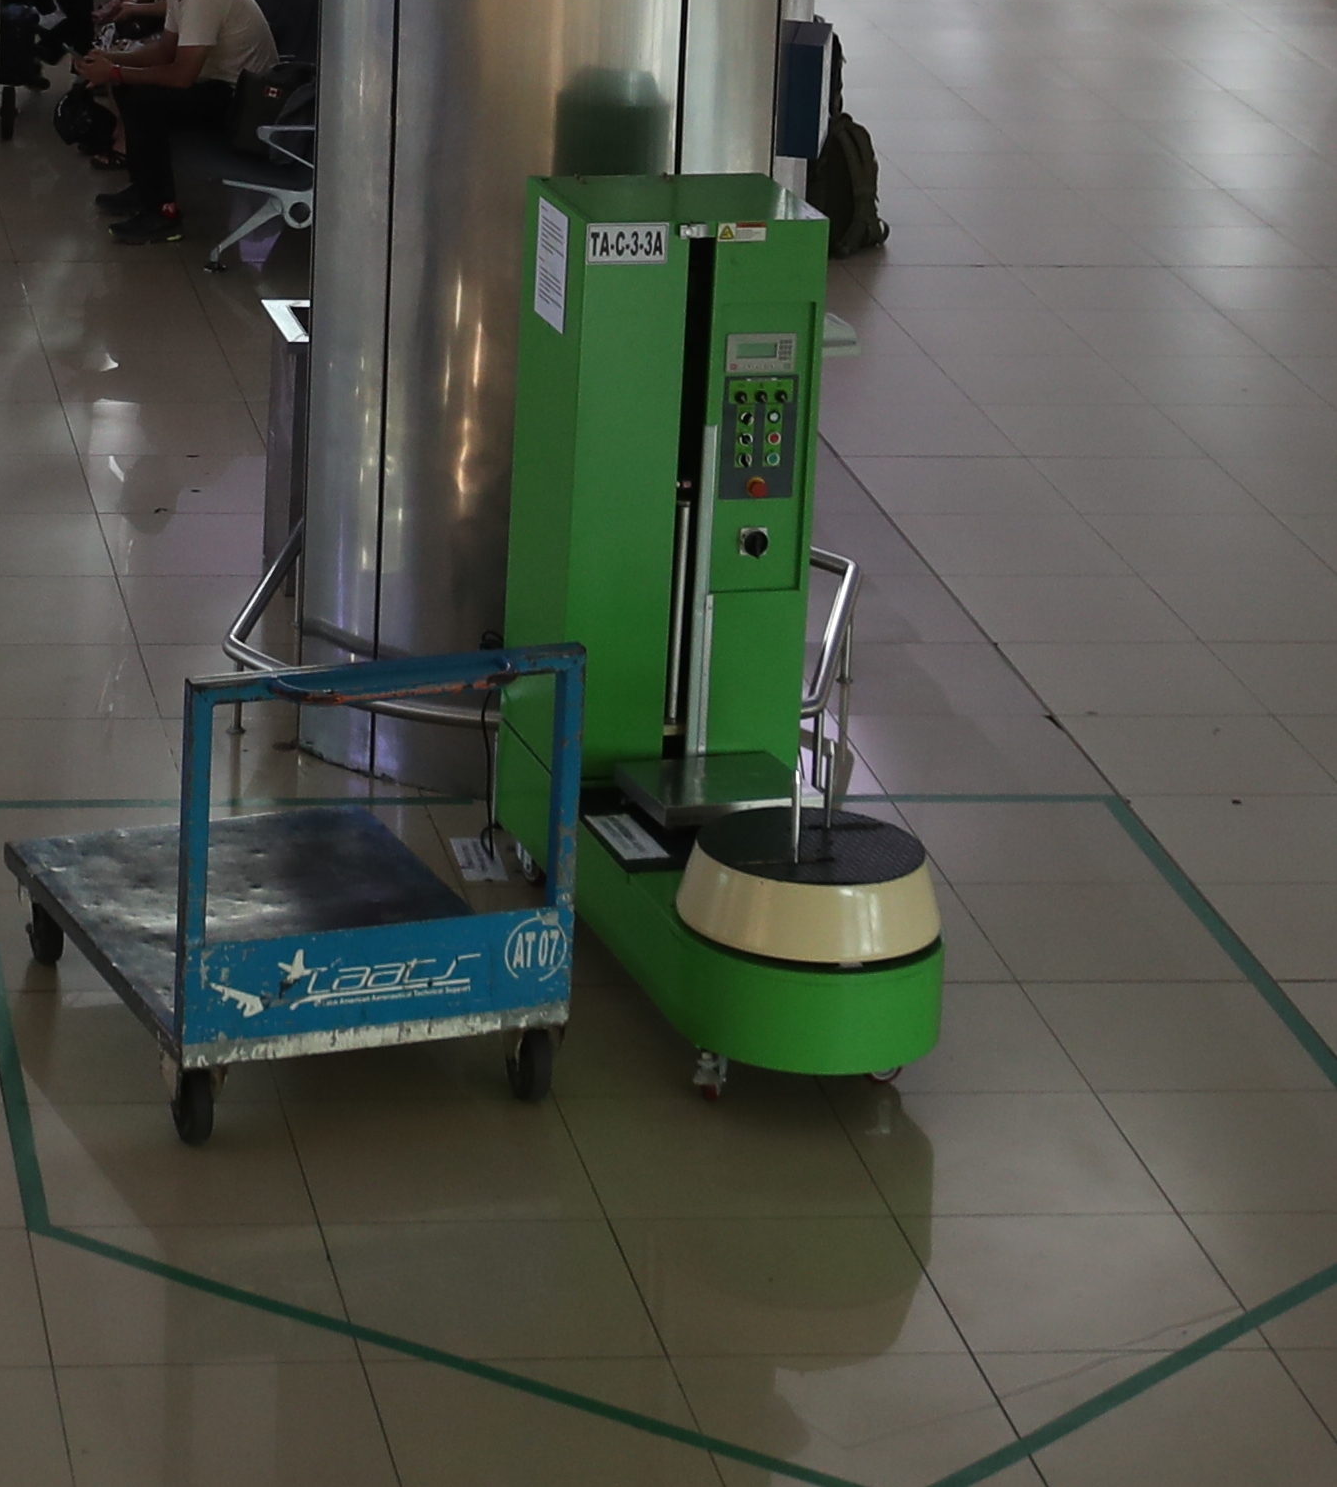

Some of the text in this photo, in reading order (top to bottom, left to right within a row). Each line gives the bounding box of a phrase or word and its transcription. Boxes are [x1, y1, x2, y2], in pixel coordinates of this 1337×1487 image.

[590, 231, 664, 257] TA-C-3-3A
[512, 928, 561, 969] AT 07
